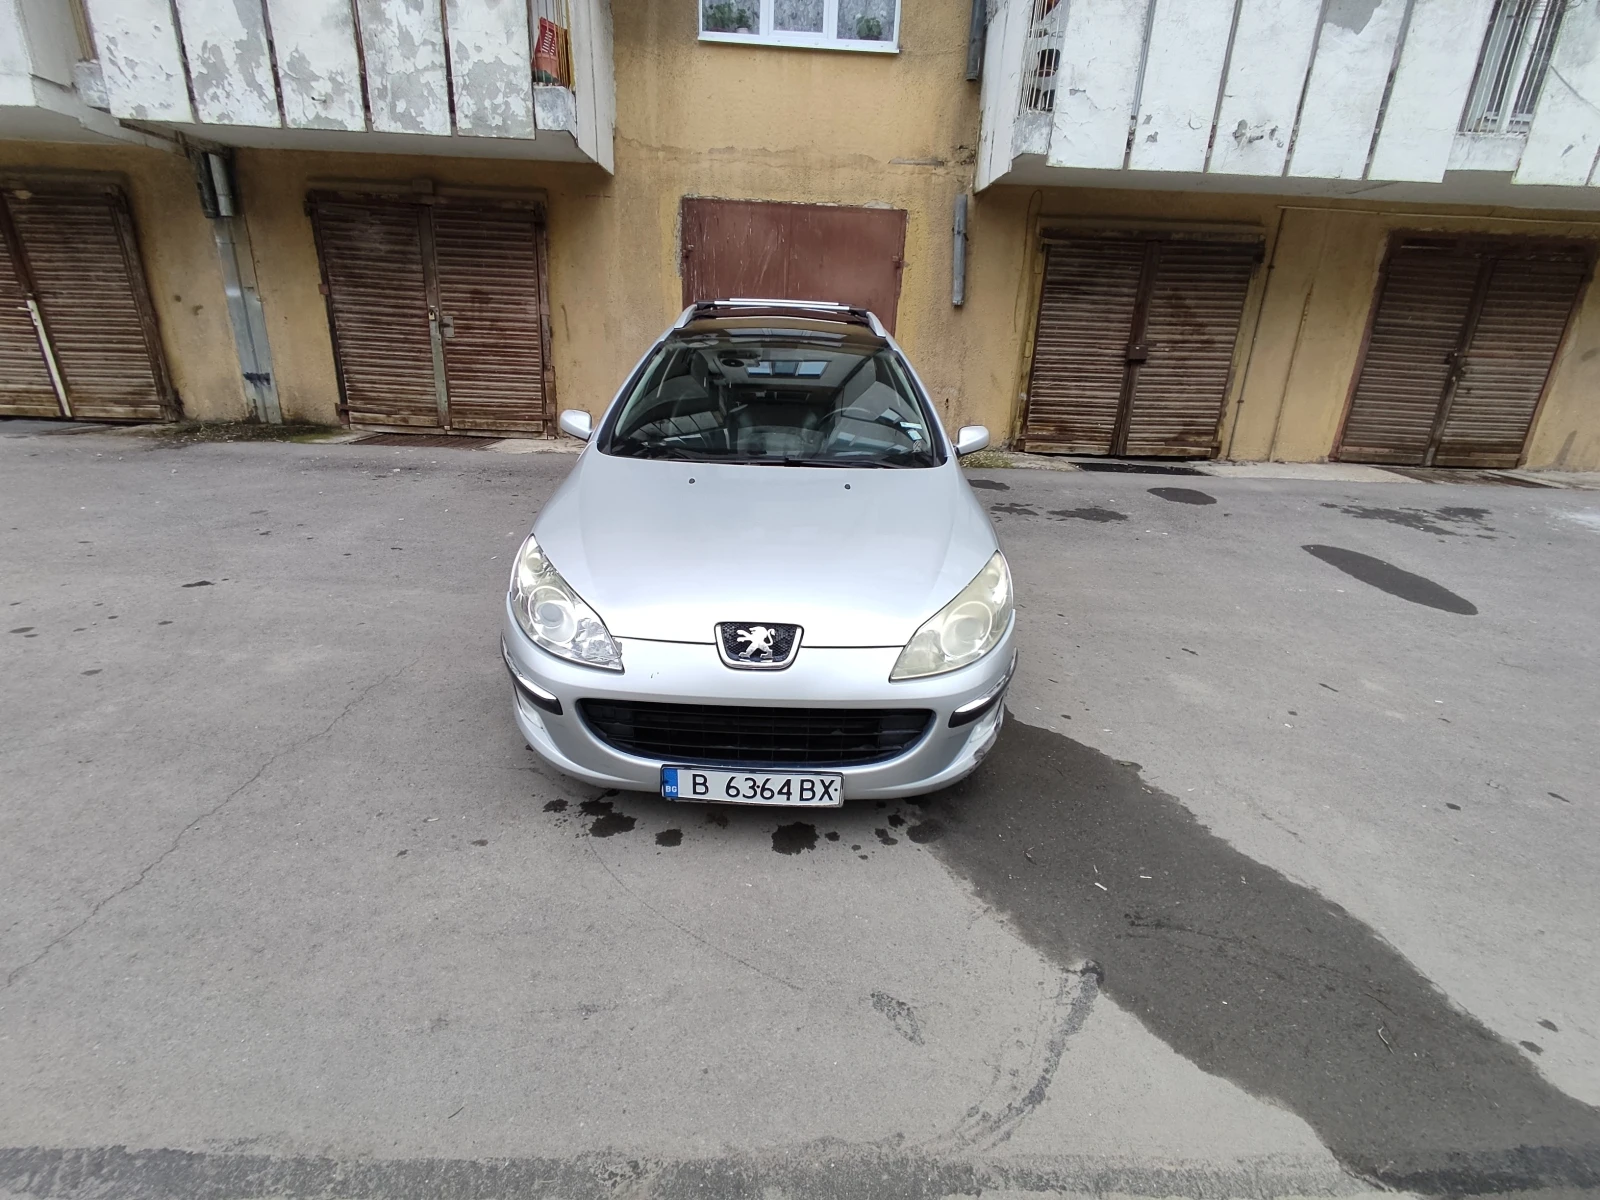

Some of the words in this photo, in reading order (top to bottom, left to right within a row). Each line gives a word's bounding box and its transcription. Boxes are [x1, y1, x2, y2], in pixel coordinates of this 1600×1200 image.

[665, 785, 678, 793] BG
[692, 773, 709, 795] B
[725, 776, 793, 801] 6364
[799, 779, 836, 801] BX
